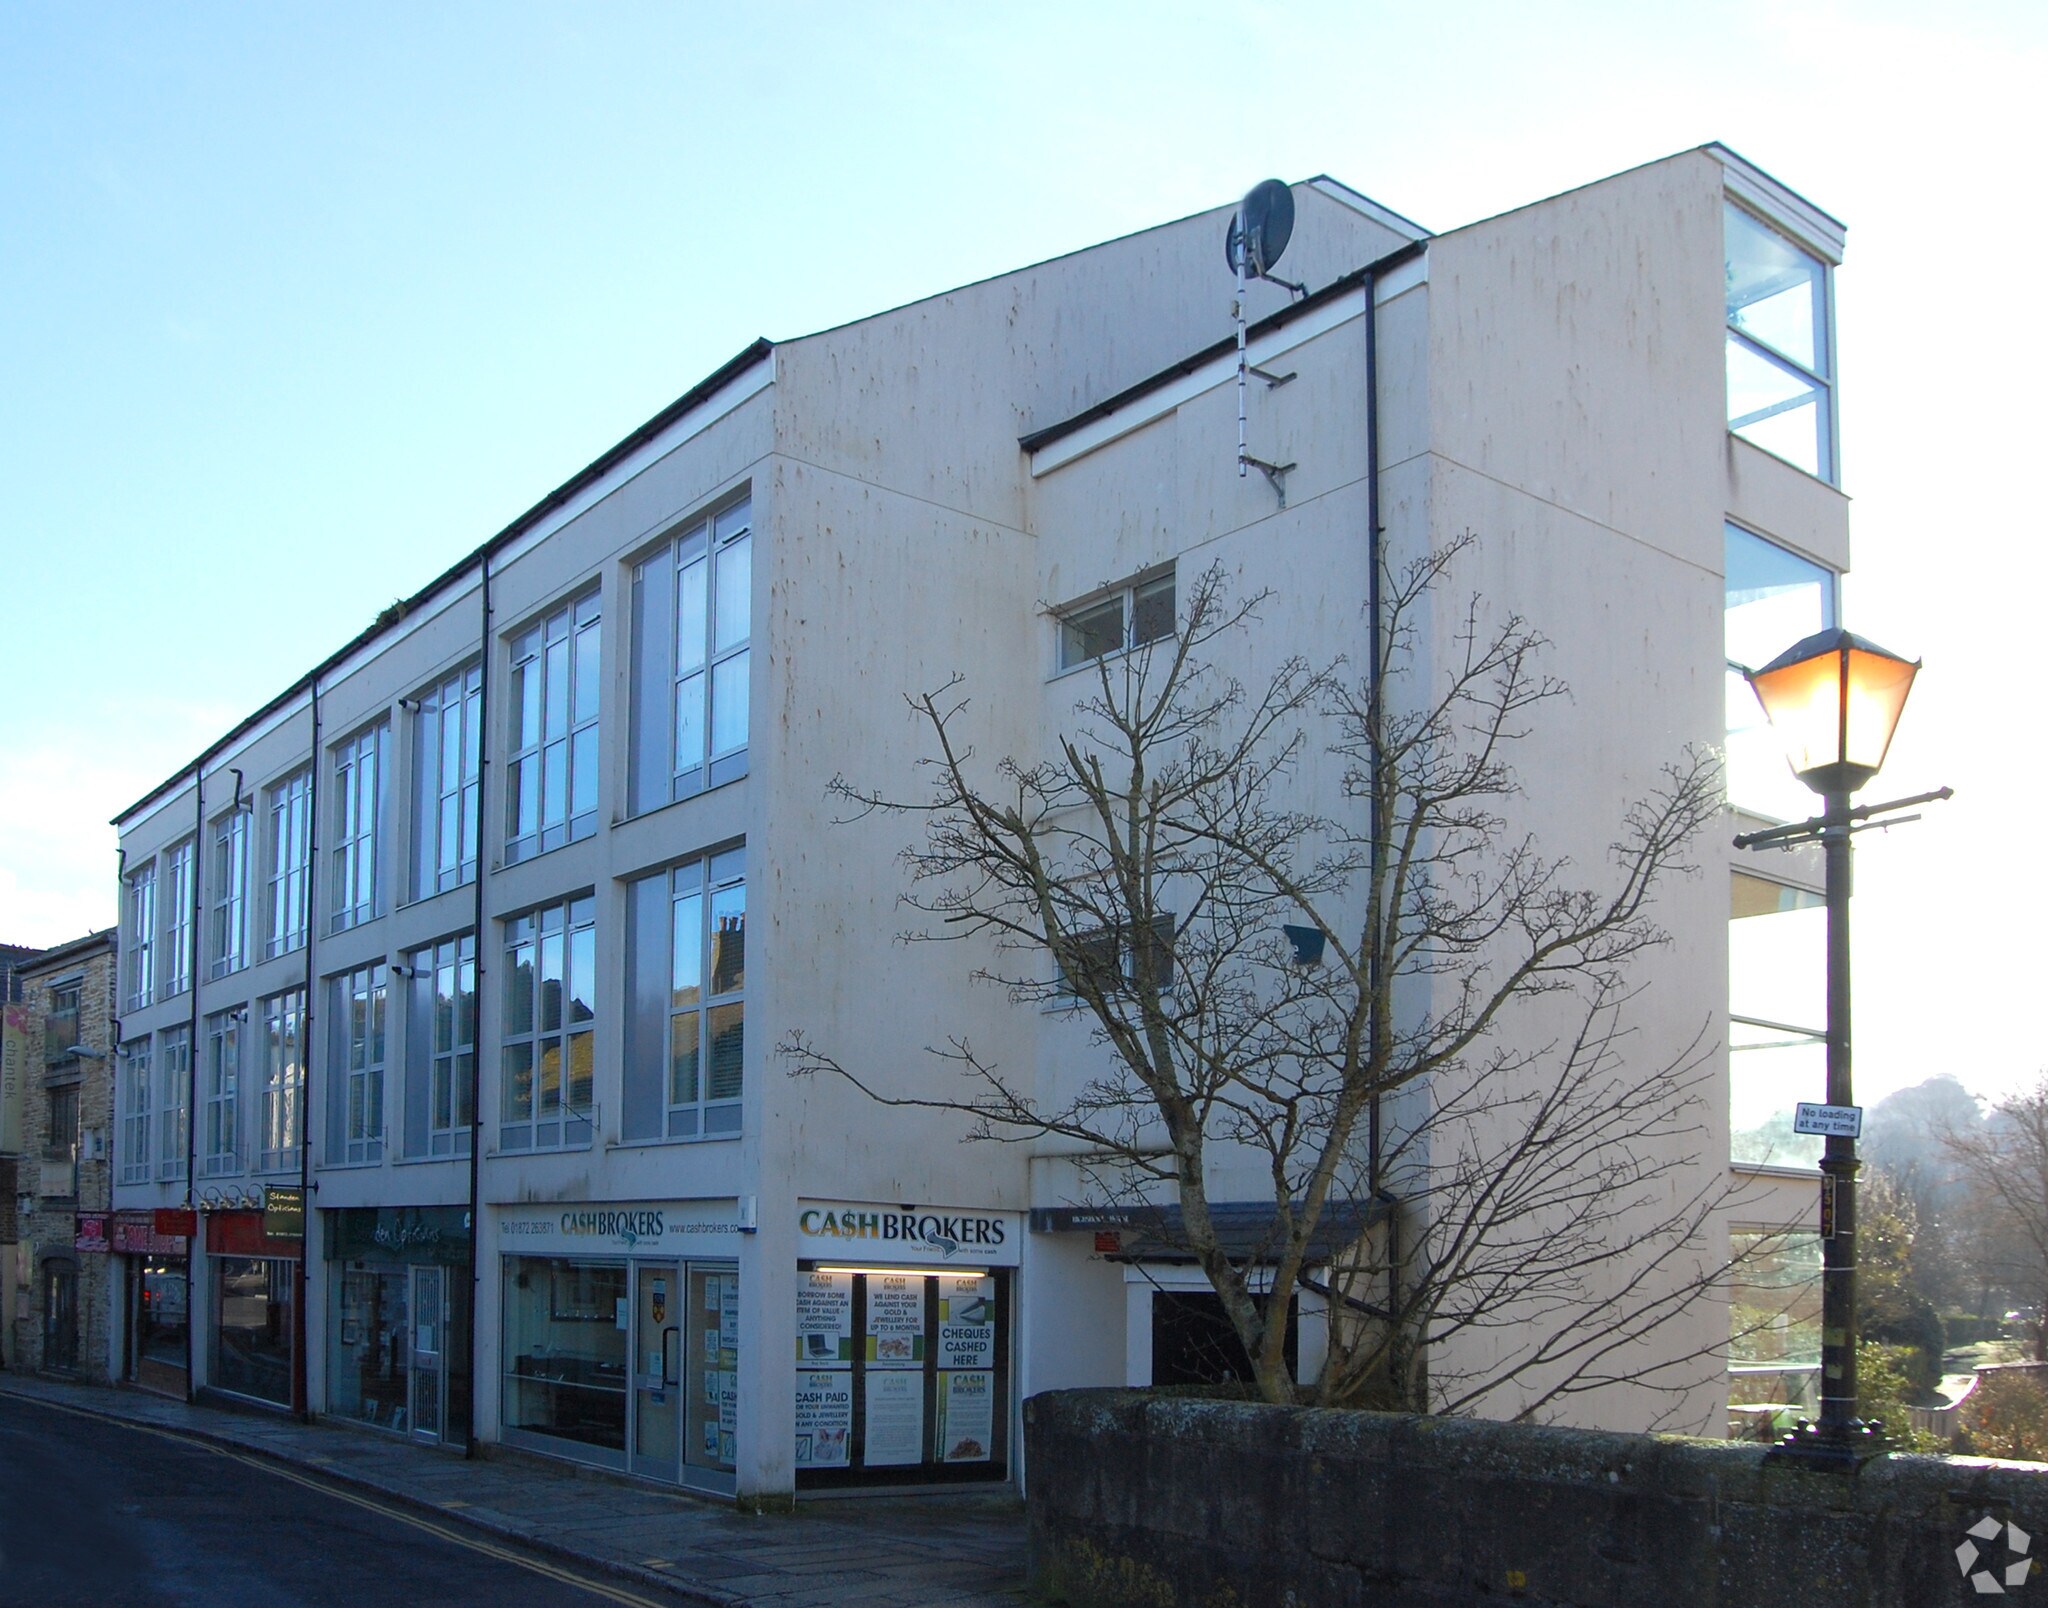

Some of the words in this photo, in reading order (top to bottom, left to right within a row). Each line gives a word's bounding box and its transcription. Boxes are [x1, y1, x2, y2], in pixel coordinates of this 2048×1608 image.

[4, 1040, 18, 1099] chantek
[1801, 1107, 1817, 1118] No
[1818, 1108, 1856, 1122] loading
[1798, 1119, 1809, 1128] at
[1812, 1121, 1830, 1132] any
[1832, 1121, 1856, 1133] time
[901, 1293, 918, 1301] CASH
[942, 1328, 991, 1339] CHEQUES
[945, 1341, 987, 1352] CASHED
[953, 1354, 978, 1366] HERE
[825, 1392, 848, 1402] PAID
